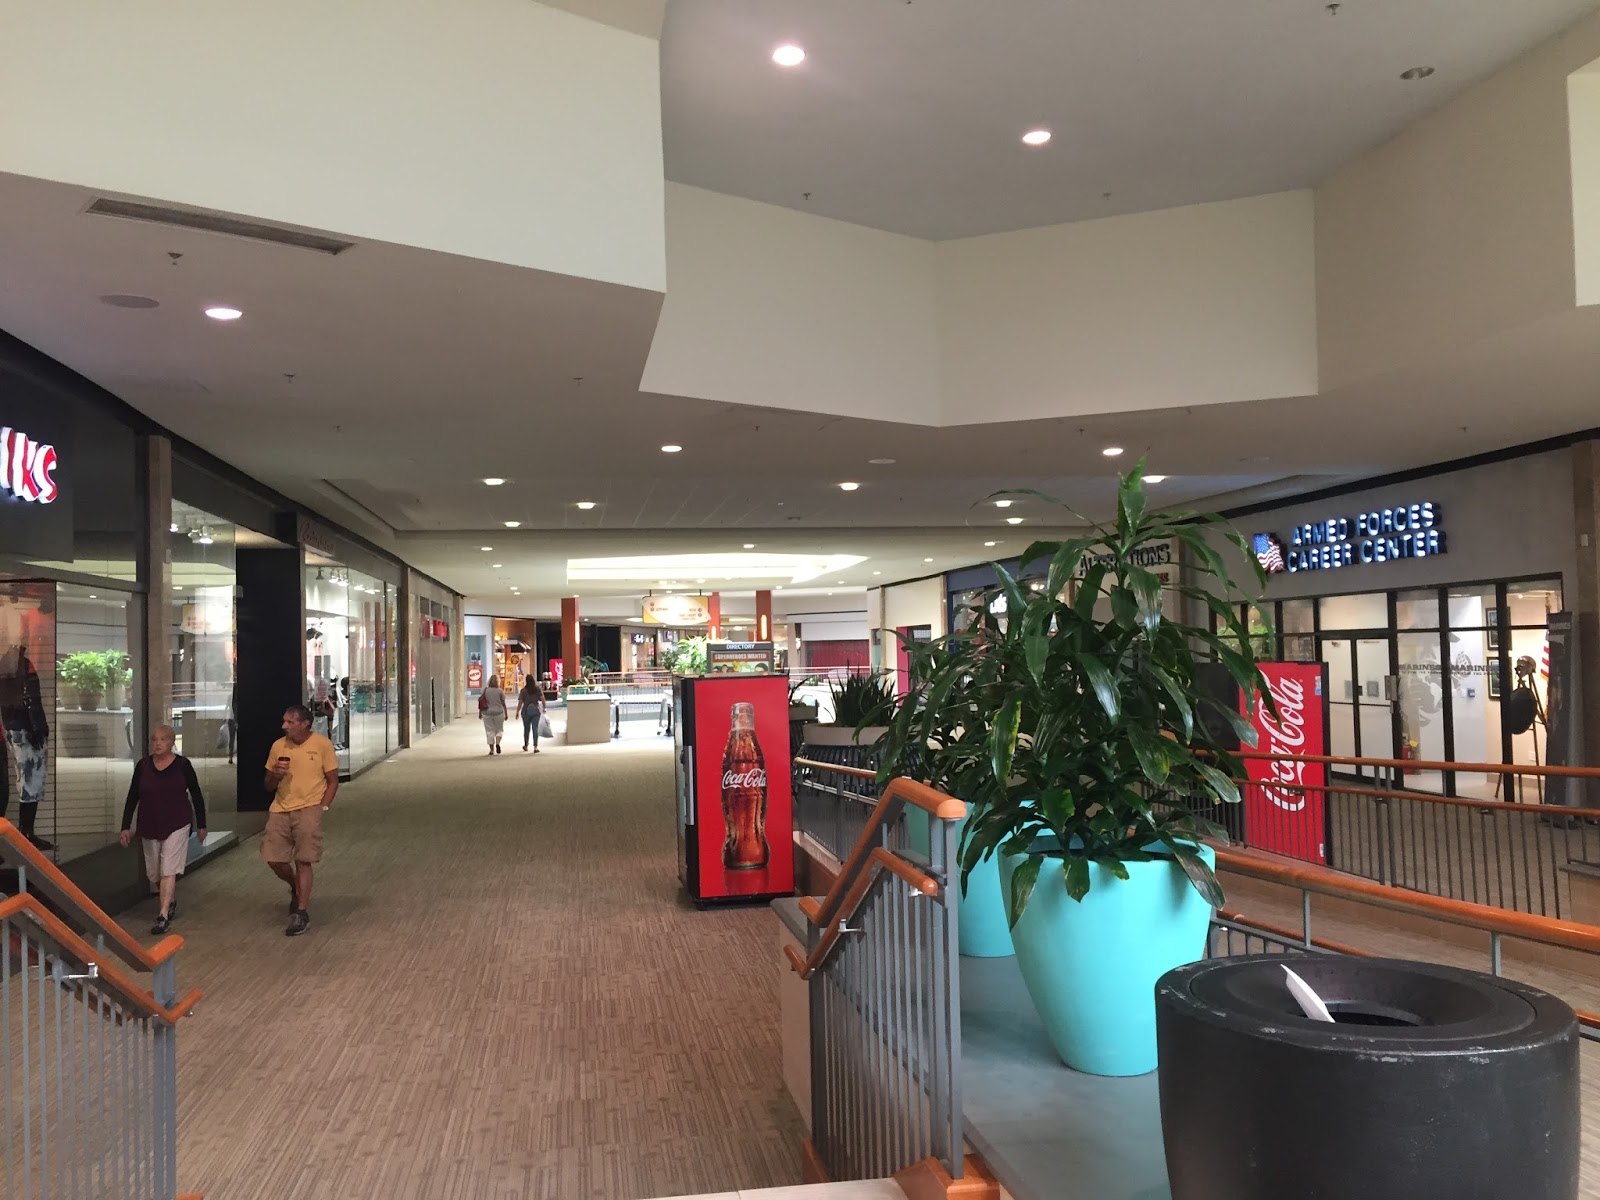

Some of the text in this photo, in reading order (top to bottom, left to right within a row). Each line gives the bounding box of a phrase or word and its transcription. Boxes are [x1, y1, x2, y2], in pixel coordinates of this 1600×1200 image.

[1292, 502, 1435, 546] ARMED FORCES
[1079, 544, 1170, 577] ALTRTIONS
[1286, 530, 1439, 573] CAREER CENTER
[722, 768, 767, 789] Coca-Cola
